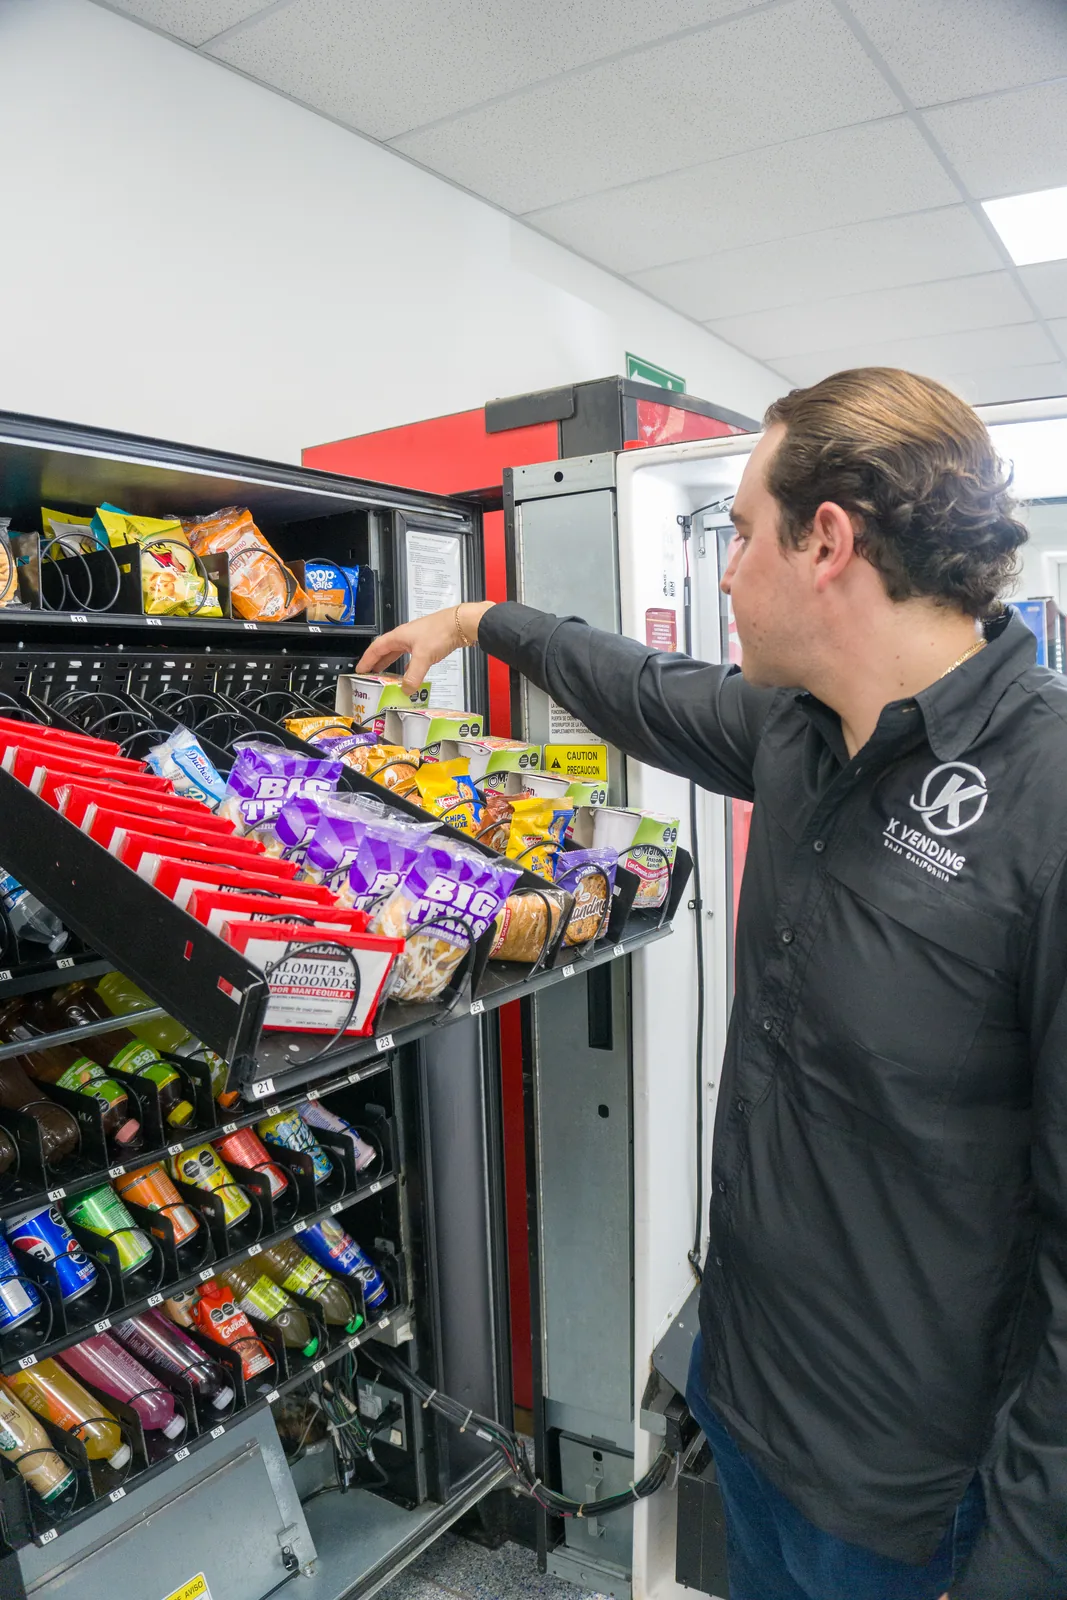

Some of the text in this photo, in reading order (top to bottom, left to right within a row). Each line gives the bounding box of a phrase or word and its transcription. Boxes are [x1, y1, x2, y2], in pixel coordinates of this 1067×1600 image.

[567, 752, 598, 760] CAUTION
[186, 749, 214, 785] Duchess
[567, 766, 600, 774] PRECAUCION
[886, 817, 966, 871] K VENDING
[884, 839, 950, 883] BAJA CALIFORNIA
[423, 875, 498, 918] BIG
[408, 900, 488, 940] TEXAS
[291, 987, 351, 998] MANTEQUILLA
[472, 1002, 481, 1011] 25
[379, 1037, 390, 1048] 23
[257, 1082, 270, 1094] 21
[226, 1125, 235, 1133] 44
[112, 1168, 122, 1176] 42
[52, 1191, 62, 1199] 41
[202, 1269, 212, 1277] 53
[151, 1295, 160, 1303] 52
[98, 1322, 108, 1330] 51
[22, 1356, 33, 1365] 50
[213, 1427, 222, 1436] 63
[177, 1450, 186, 1458] 62
[113, 1489, 122, 1498] 61
[43, 1532, 54, 1541] 60
[184, 1580, 203, 1598] AVISO
